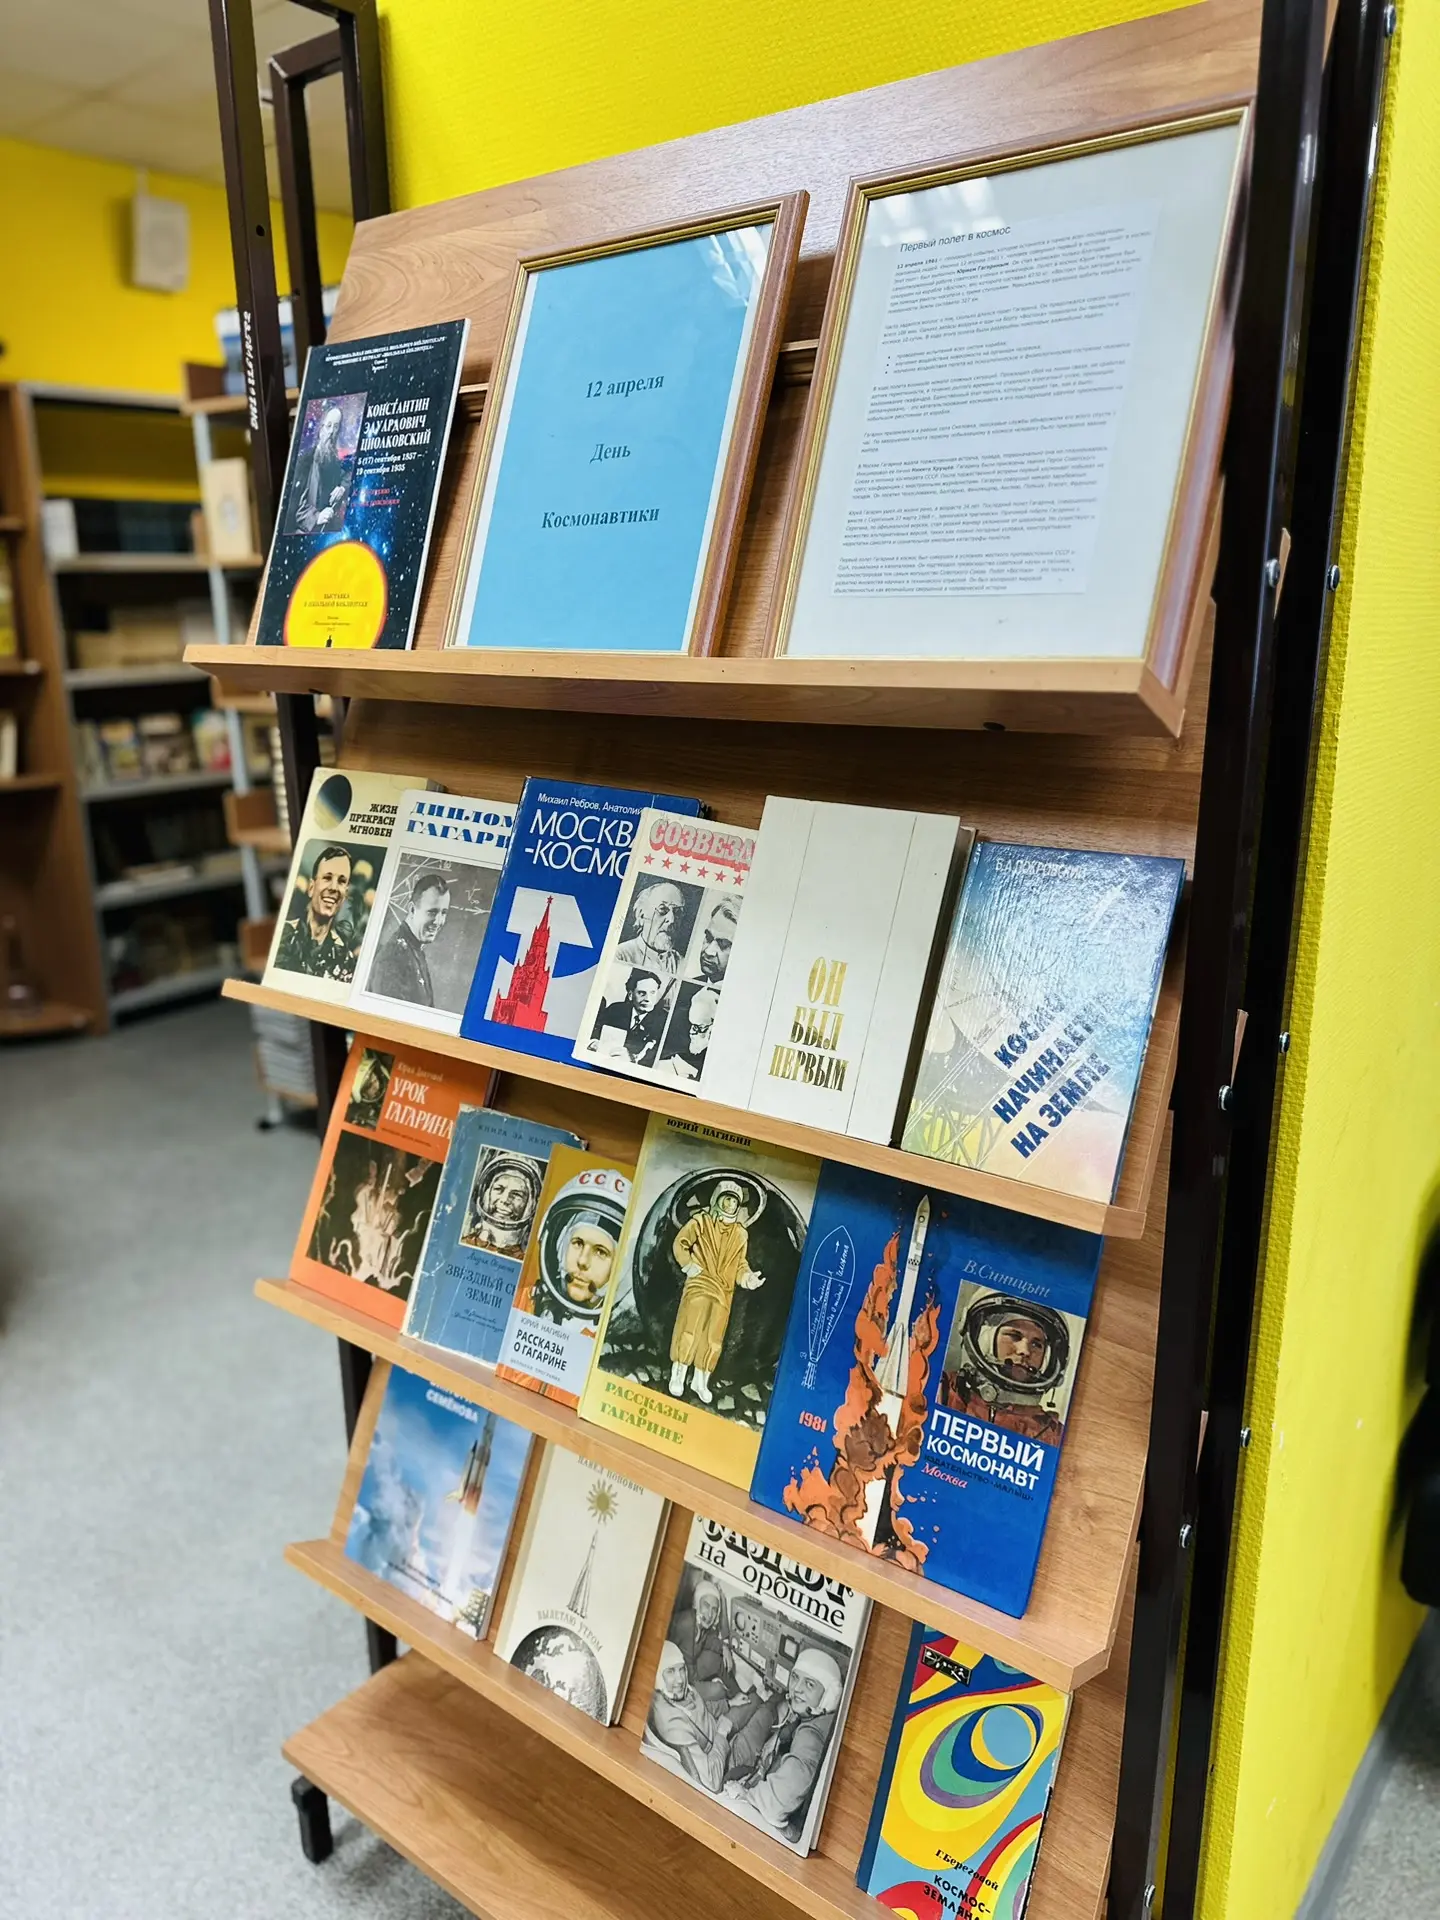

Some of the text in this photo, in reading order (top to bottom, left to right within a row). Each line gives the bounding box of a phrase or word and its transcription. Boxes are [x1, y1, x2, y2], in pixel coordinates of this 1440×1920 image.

[899, 238, 936, 253] Первый
[937, 234, 965, 245] полет
[975, 226, 1011, 239] космос
[586, 375, 665, 398] 12 апреля
[367, 398, 430, 418] КОНСТАНТИН
[364, 415, 427, 435] ЭДУАРДОВИЧ
[361, 429, 431, 452] ЦИОЛКОВСКИЙ
[590, 443, 631, 464] День
[364, 464, 390, 475] сентября
[374, 454, 401, 464] сентября
[541, 508, 660, 529] Космонавтики
[537, 792, 569, 806] Михаил
[570, 797, 601, 811] Ребров,
[348, 824, 393, 838] МГНОВЕН
[349, 813, 396, 826] ПРЕКРАСН
[808, 956, 848, 1007] ОН
[789, 1005, 844, 1051] БЫЛ
[768, 1044, 849, 1091] ПЕРВЫМ
[391, 1076, 430, 1105] УРОК
[1010, 1052, 1111, 1159] НА ЗЕМЛЕ
[384, 1100, 454, 1140] ГАГАРИНА
[478, 1125, 507, 1137] КНИГА
[666, 1118, 752, 1147] ЮРИЙ НАГИБИН
[962, 1259, 1051, 1298] В.Синицын
[465, 1287, 503, 1309] ЗЕМЛИ
[520, 1316, 539, 1330] ЮРИЙ
[541, 1325, 570, 1341] НАГИБИН
[513, 1341, 567, 1371] О ГАГАРИНЕ
[516, 1329, 564, 1356] РАССКАЗЫ
[605, 1381, 689, 1424] РАССКАЗЫ
[638, 1407, 648, 1417] О
[600, 1401, 684, 1445] ГАГАРИНЕ
[798, 1410, 827, 1433] 1981
[930, 1408, 1045, 1472] ПЕРВЫЙ
[921, 1462, 969, 1489] Москва
[926, 1434, 1039, 1491] КОСМОНАВТ
[606, 1469, 645, 1496] ПОПОВИЧ
[699, 1540, 846, 1628] на орбите
[933, 1874, 991, 1914] КОСМОС-
